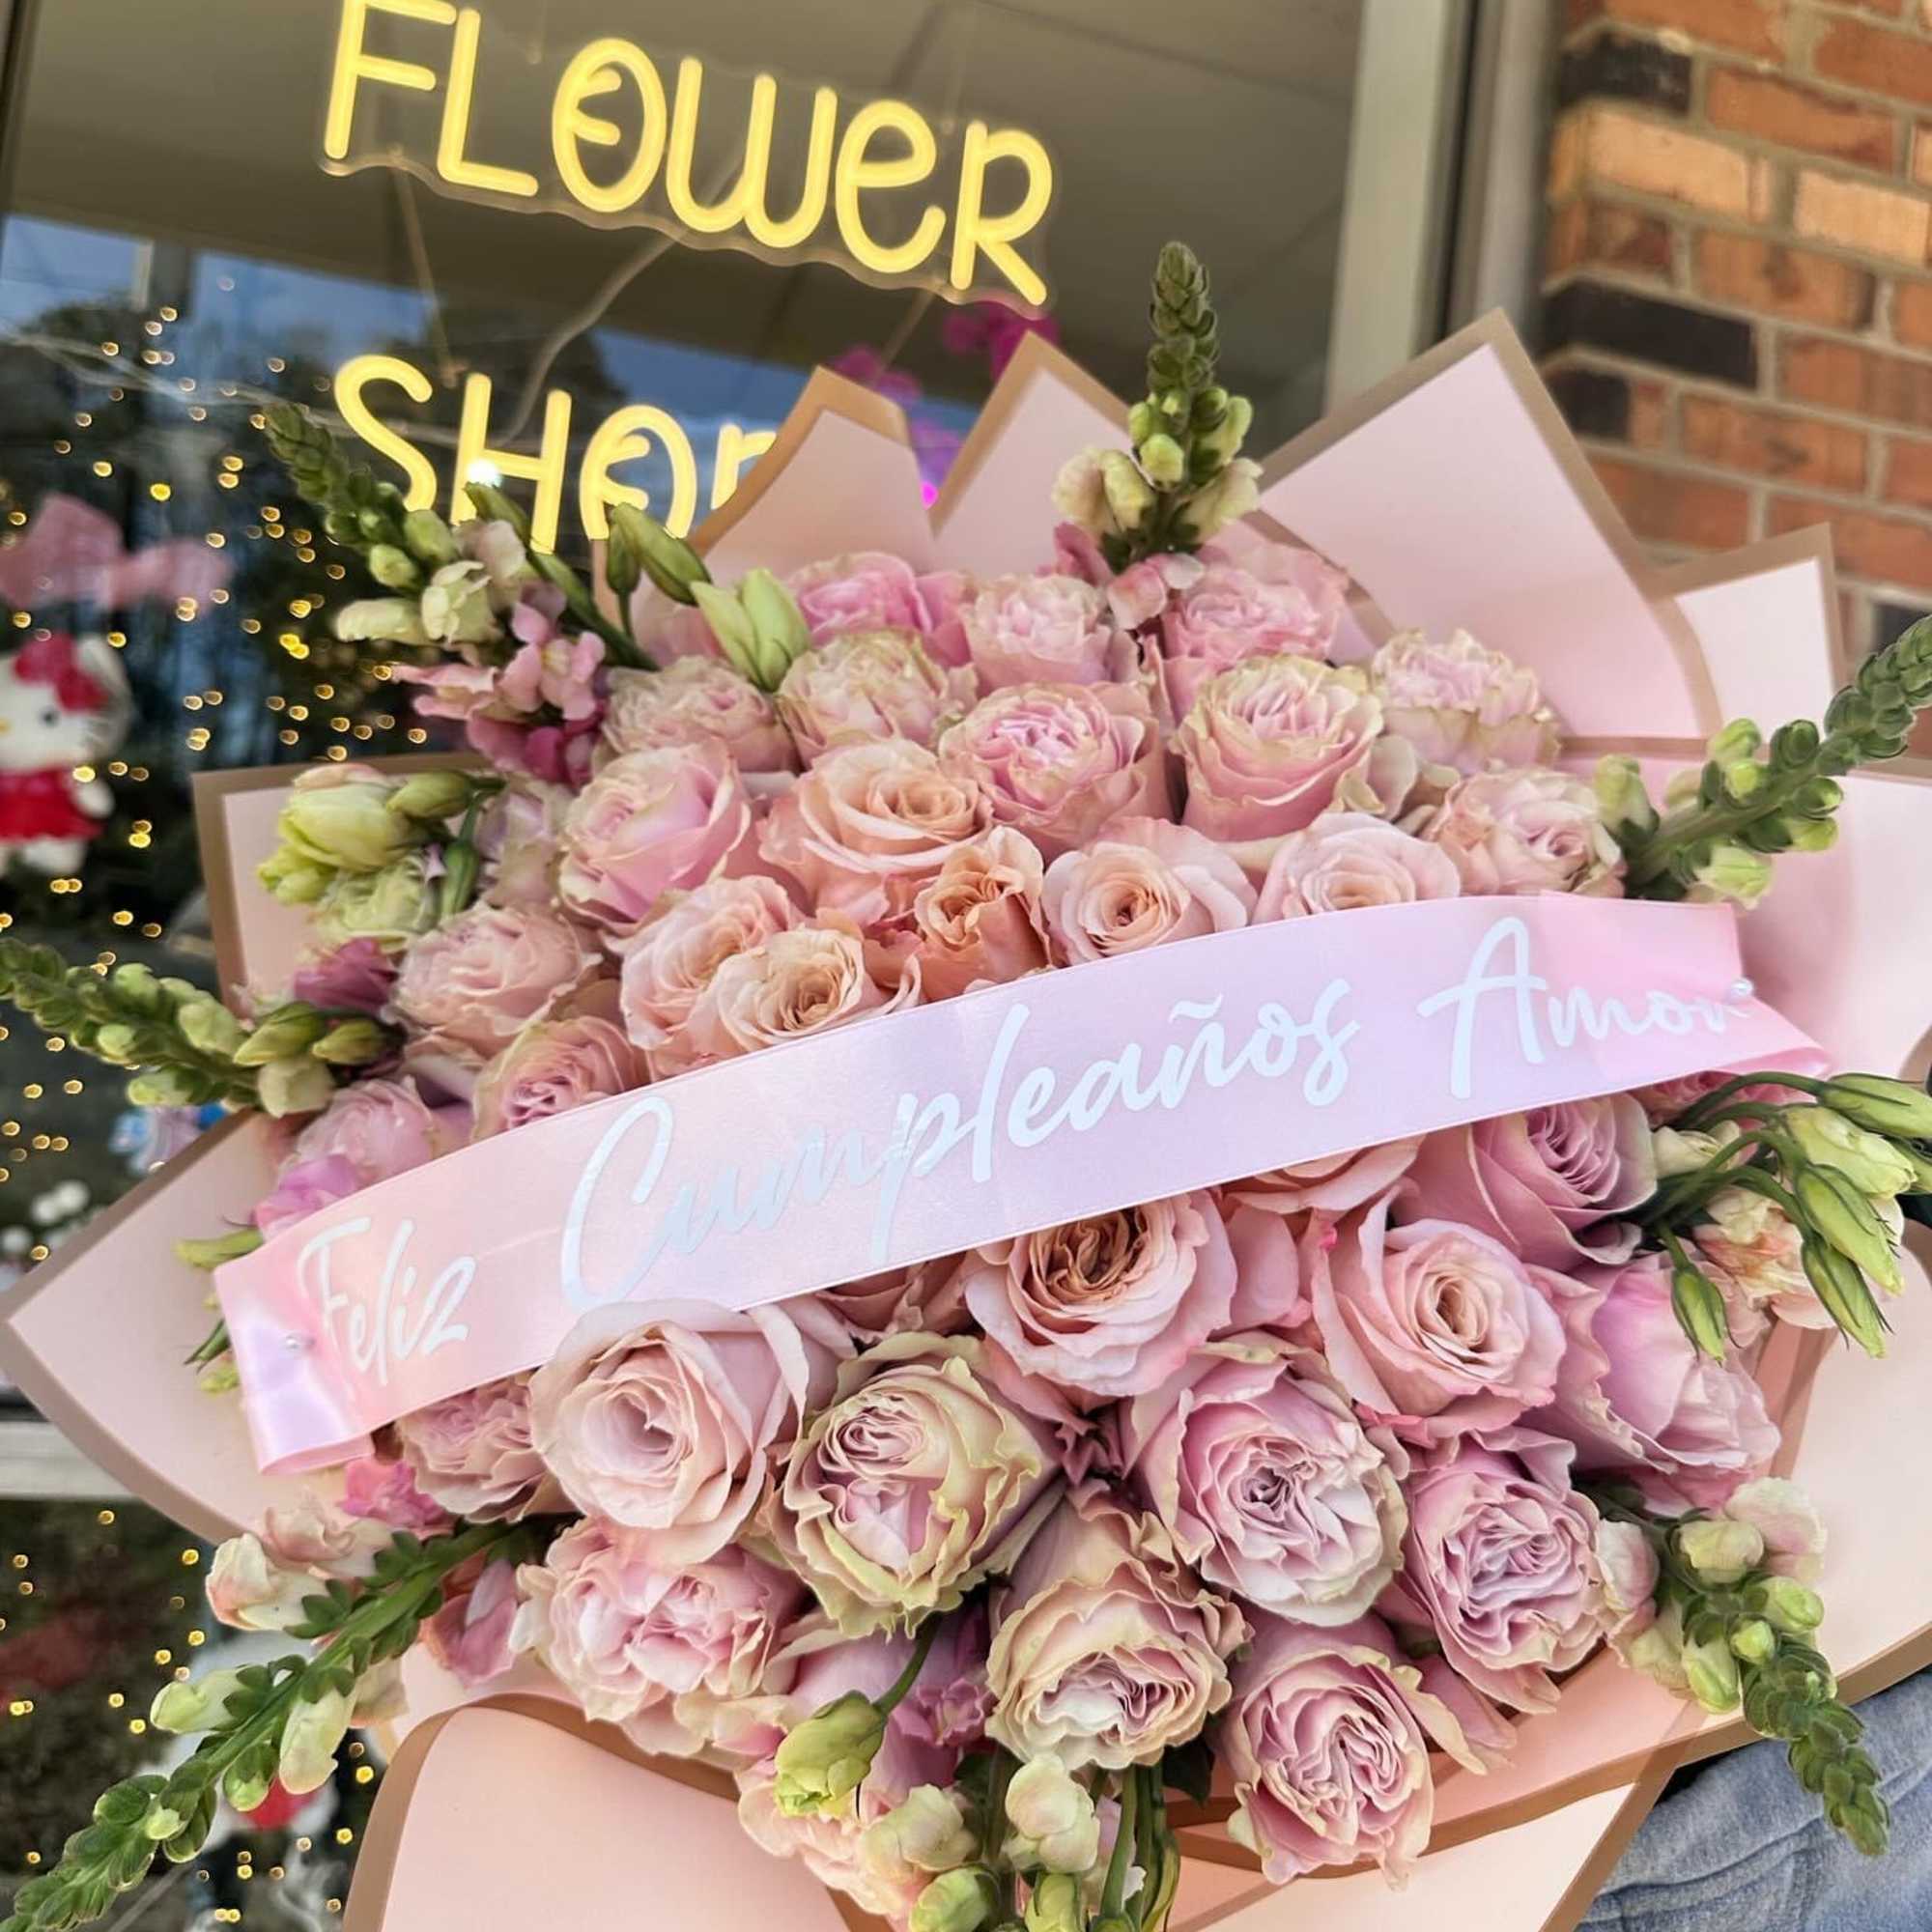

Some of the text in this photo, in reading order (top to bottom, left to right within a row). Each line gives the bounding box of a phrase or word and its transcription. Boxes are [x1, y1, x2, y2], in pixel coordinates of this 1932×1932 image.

[325, 0, 1053, 306] FLOWER
[298, 916, 1749, 1386] Feliz Cumpleaños Amor
